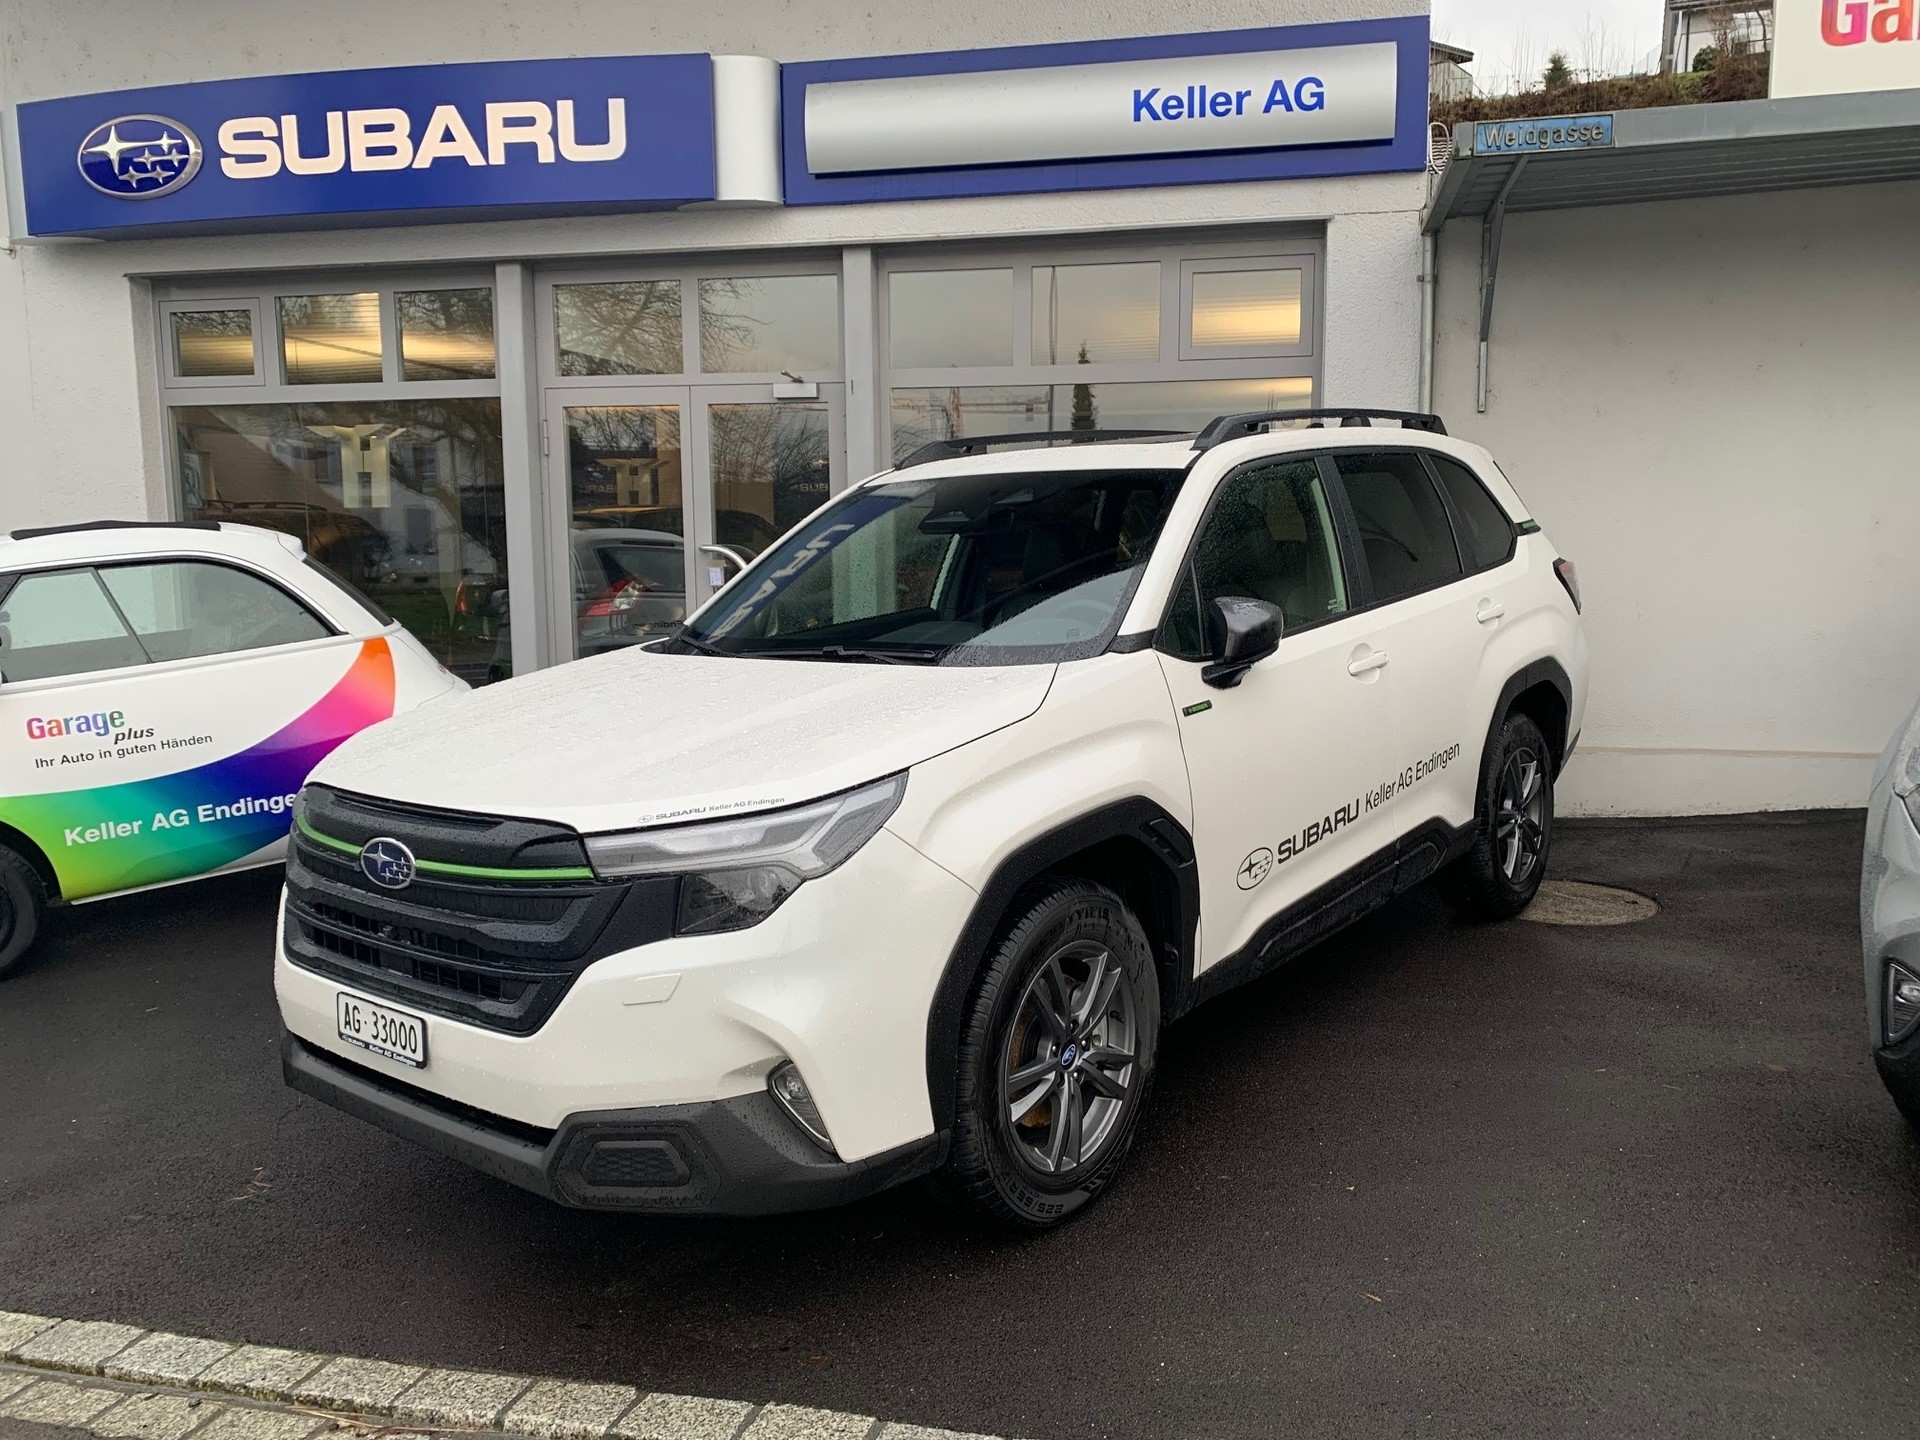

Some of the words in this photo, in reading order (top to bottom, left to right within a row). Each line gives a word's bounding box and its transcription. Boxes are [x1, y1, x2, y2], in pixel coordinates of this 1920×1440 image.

[1821, 0, 1920, 46] Ga
[1133, 85, 1252, 122] Keller
[1262, 77, 1325, 113] AG
[218, 98, 627, 180] SUBARU
[1484, 121, 1604, 150] Weidgasse
[26, 710, 125, 741] Garage
[113, 727, 155, 745] plus
[35, 757, 55, 769] Ihr
[60, 752, 95, 766] Auto
[98, 748, 112, 760] in
[116, 742, 157, 759] guten
[160, 733, 213, 751] Händen
[63, 818, 143, 847] Keller
[151, 808, 190, 832] AG
[197, 793, 297, 823] Endinge
[656, 807, 706, 819] SUBARU
[747, 797, 785, 807] Endingen
[1277, 798, 1360, 865] SUBARU
[1365, 779, 1397, 813] Keller
[1397, 767, 1413, 794] AG
[1415, 742, 1460, 781] Endingen
[344, 1002, 360, 1033] AG
[371, 1011, 417, 1054] 33000
